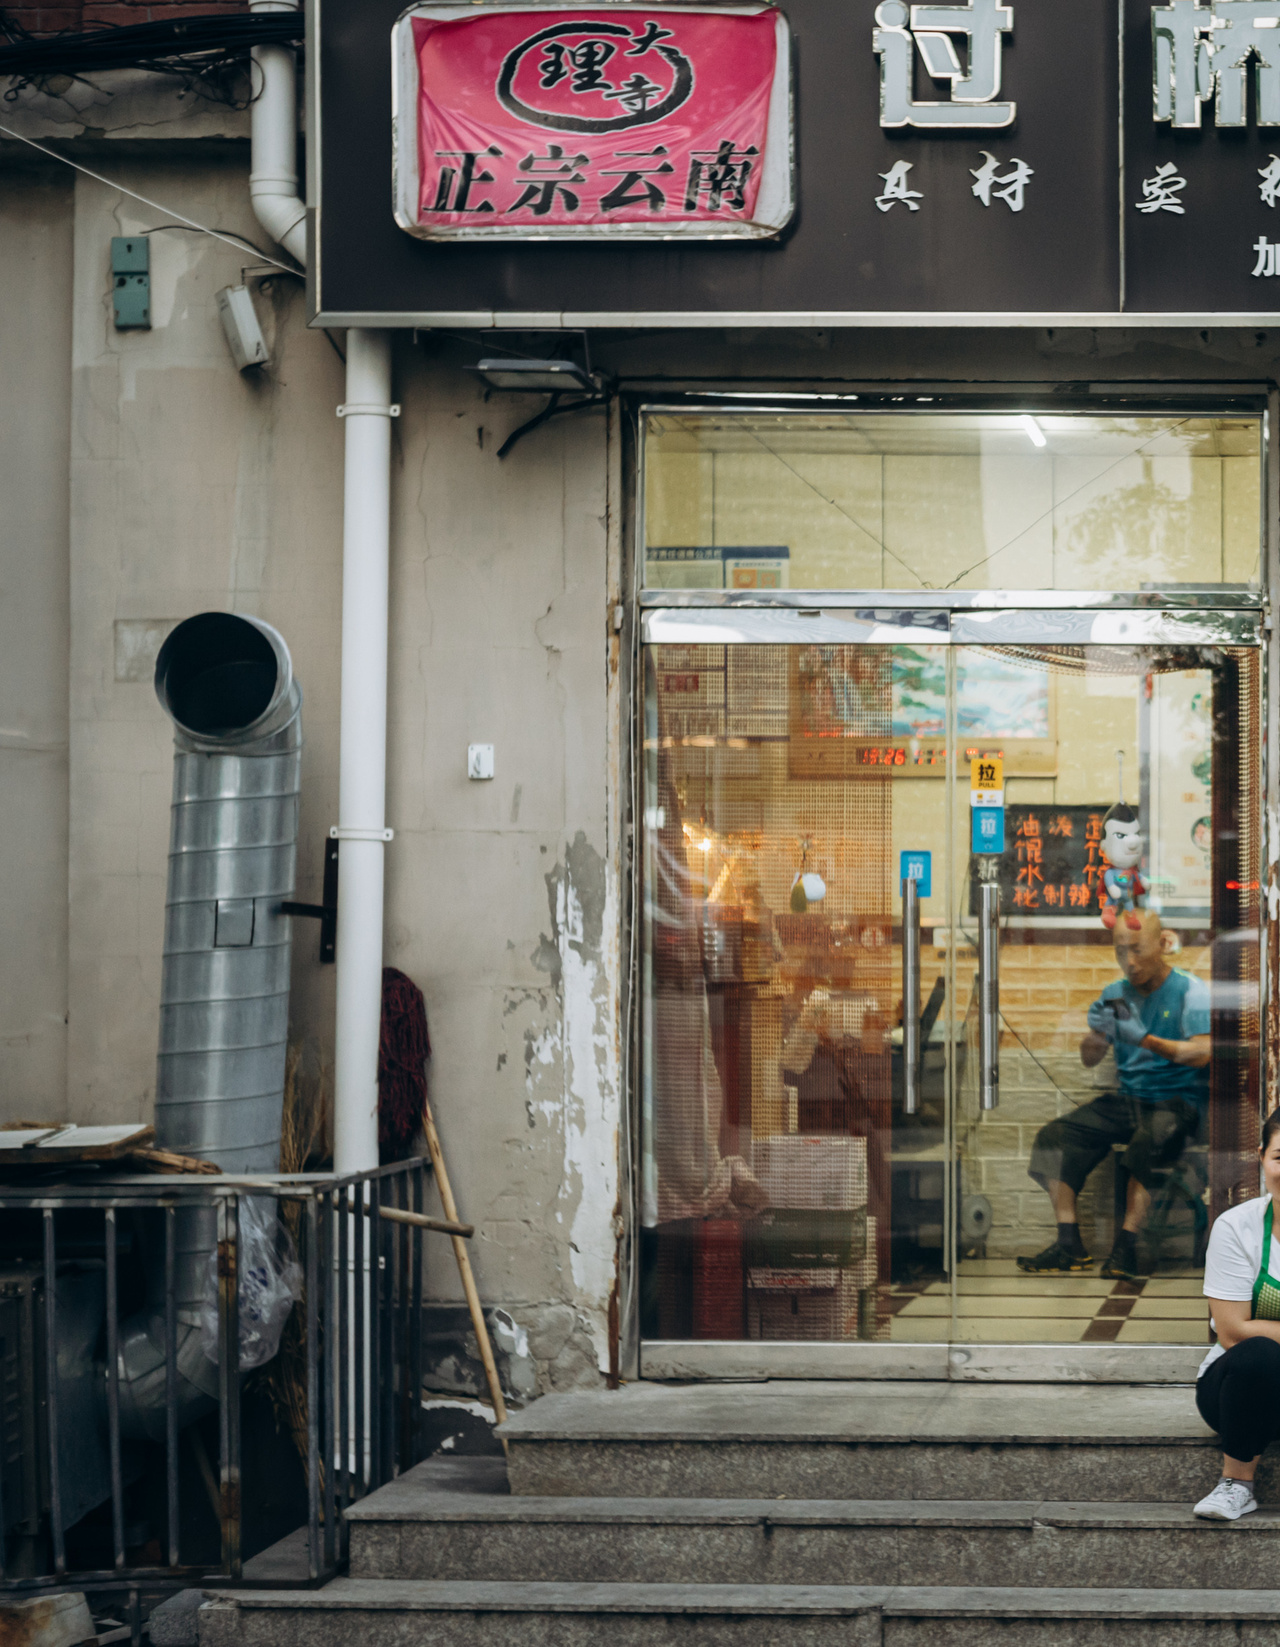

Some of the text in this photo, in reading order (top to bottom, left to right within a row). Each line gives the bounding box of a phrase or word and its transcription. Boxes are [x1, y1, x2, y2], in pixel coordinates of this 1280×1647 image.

[424, 141, 761, 215] 正宗云南
[978, 763, 996, 782] 拉
[980, 818, 997, 835] 拉
[908, 862, 924, 880] 拉
